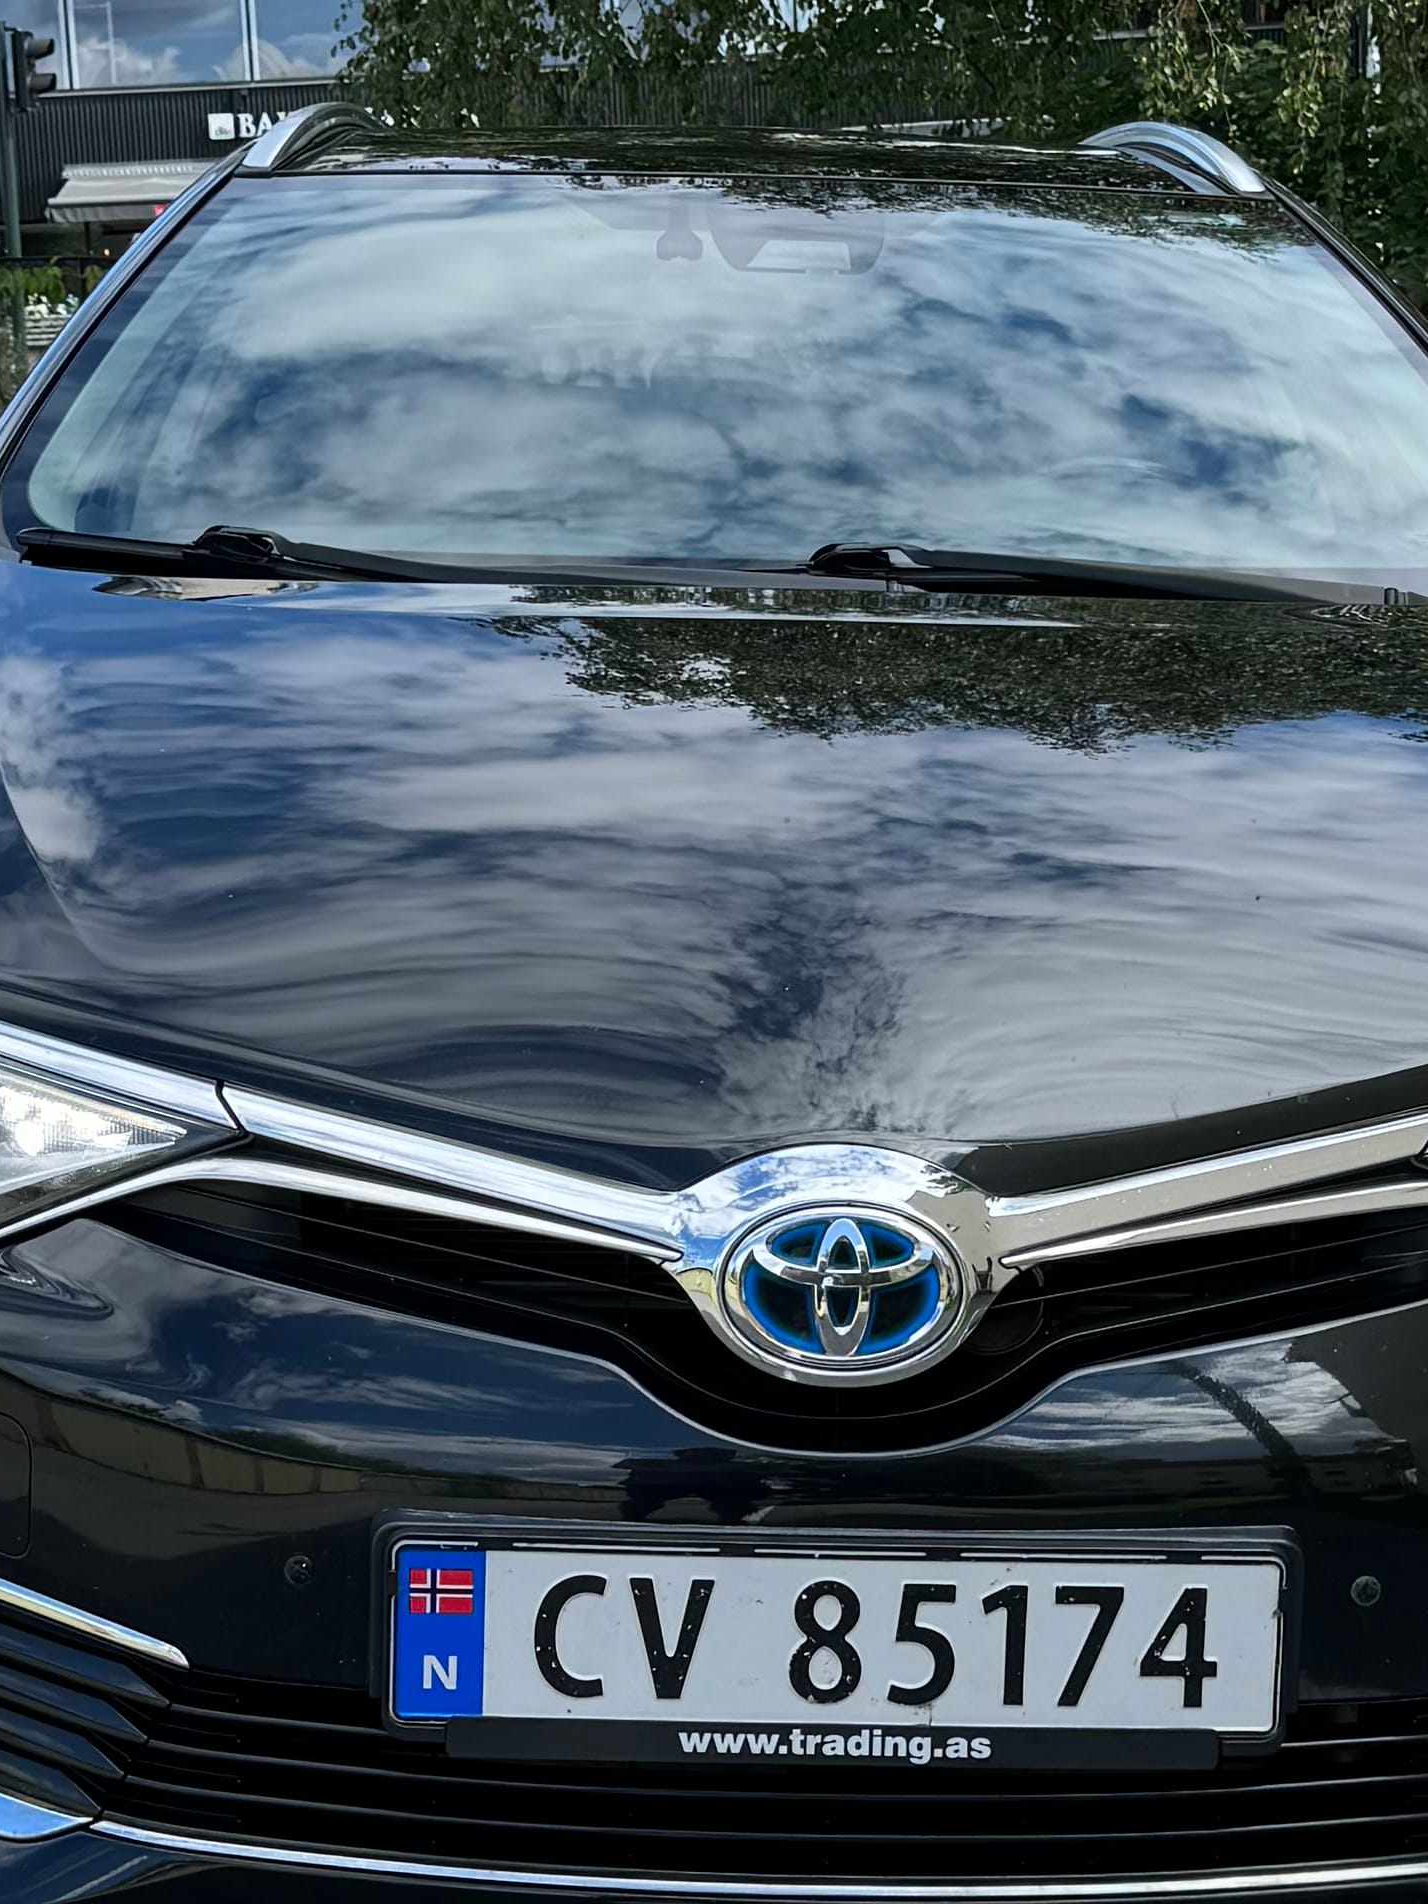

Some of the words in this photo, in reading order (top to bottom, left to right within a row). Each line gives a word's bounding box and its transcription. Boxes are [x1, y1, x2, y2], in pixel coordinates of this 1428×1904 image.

[534, 1574, 715, 1699] CV
[788, 1579, 1218, 1708] 85174
[423, 1655, 458, 1690] N
[678, 1728, 992, 1765] www.trading.as
